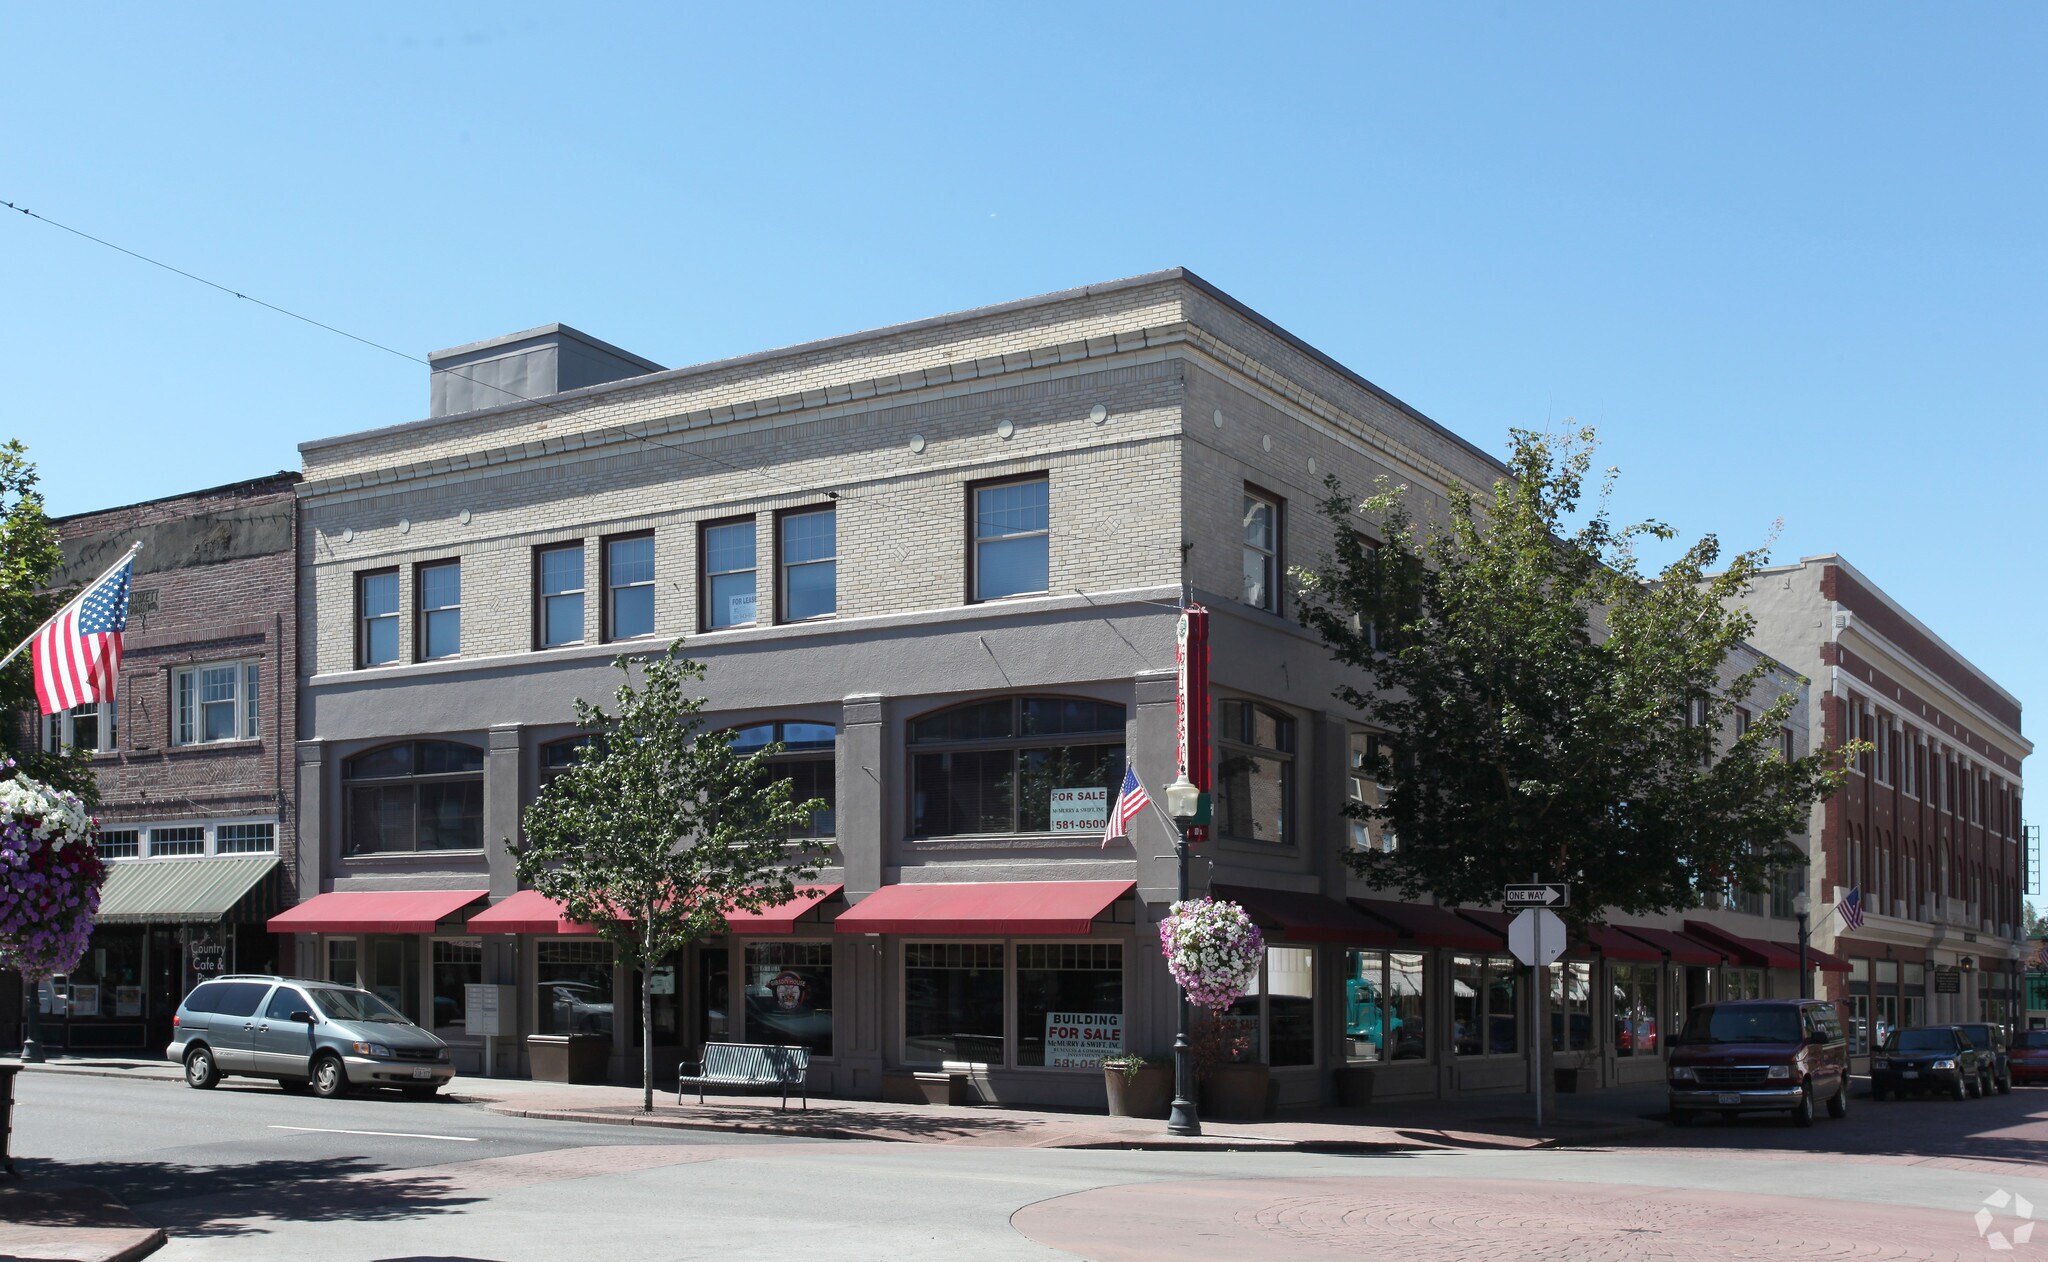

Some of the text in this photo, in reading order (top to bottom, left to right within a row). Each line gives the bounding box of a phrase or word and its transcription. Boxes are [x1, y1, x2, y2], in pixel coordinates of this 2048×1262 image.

[1052, 791, 1105, 801] FOR SALE
[1056, 819, 1106, 829] 581-0500
[1509, 891, 1545, 900] ONE WAY
[190, 940, 226, 957] Country
[192, 957, 224, 970] Cafe &
[1053, 1014, 1118, 1025] BUILDING
[1048, 1026, 1121, 1041] FOR SALE
